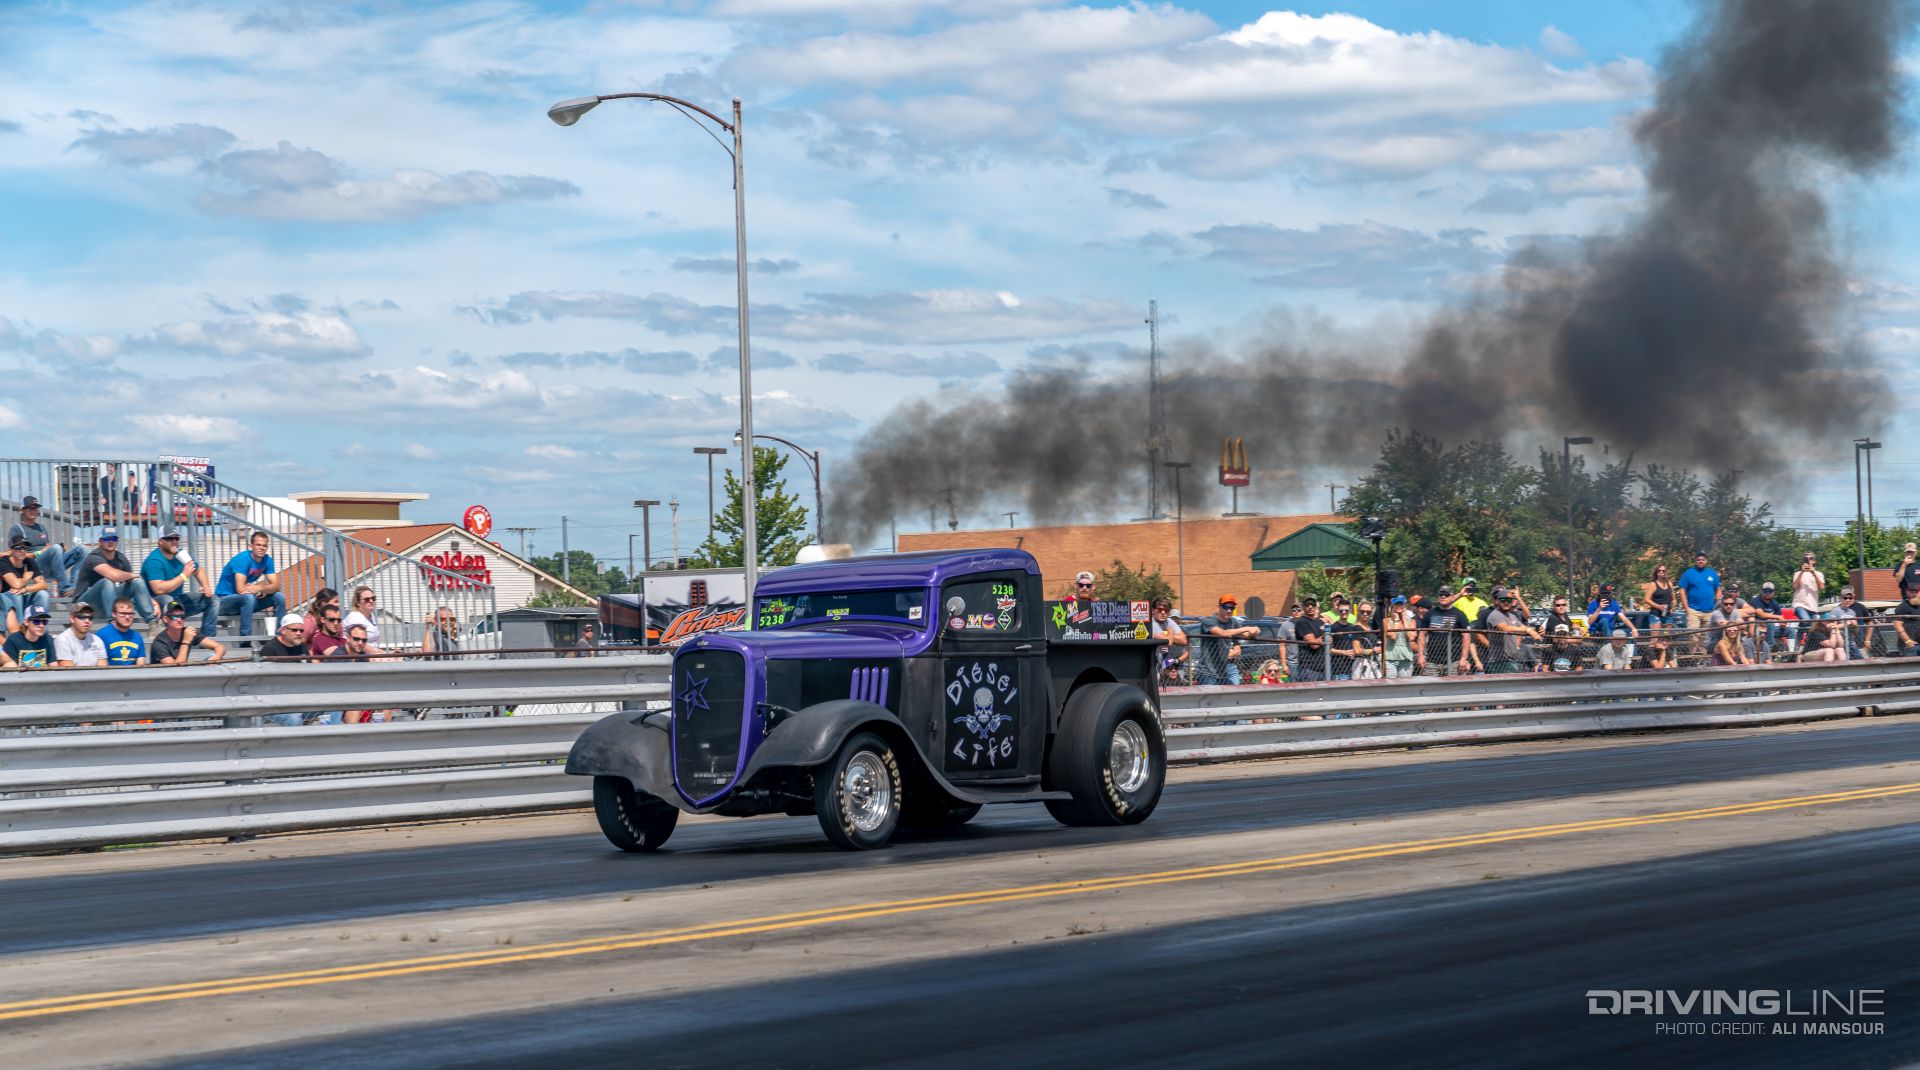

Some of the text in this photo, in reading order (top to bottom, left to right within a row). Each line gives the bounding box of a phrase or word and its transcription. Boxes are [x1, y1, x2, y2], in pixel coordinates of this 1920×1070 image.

[421, 551, 486, 579] golden
[993, 584, 1014, 596] 5238
[1109, 602, 1130, 616] Diesel
[759, 614, 784, 627] 5238
